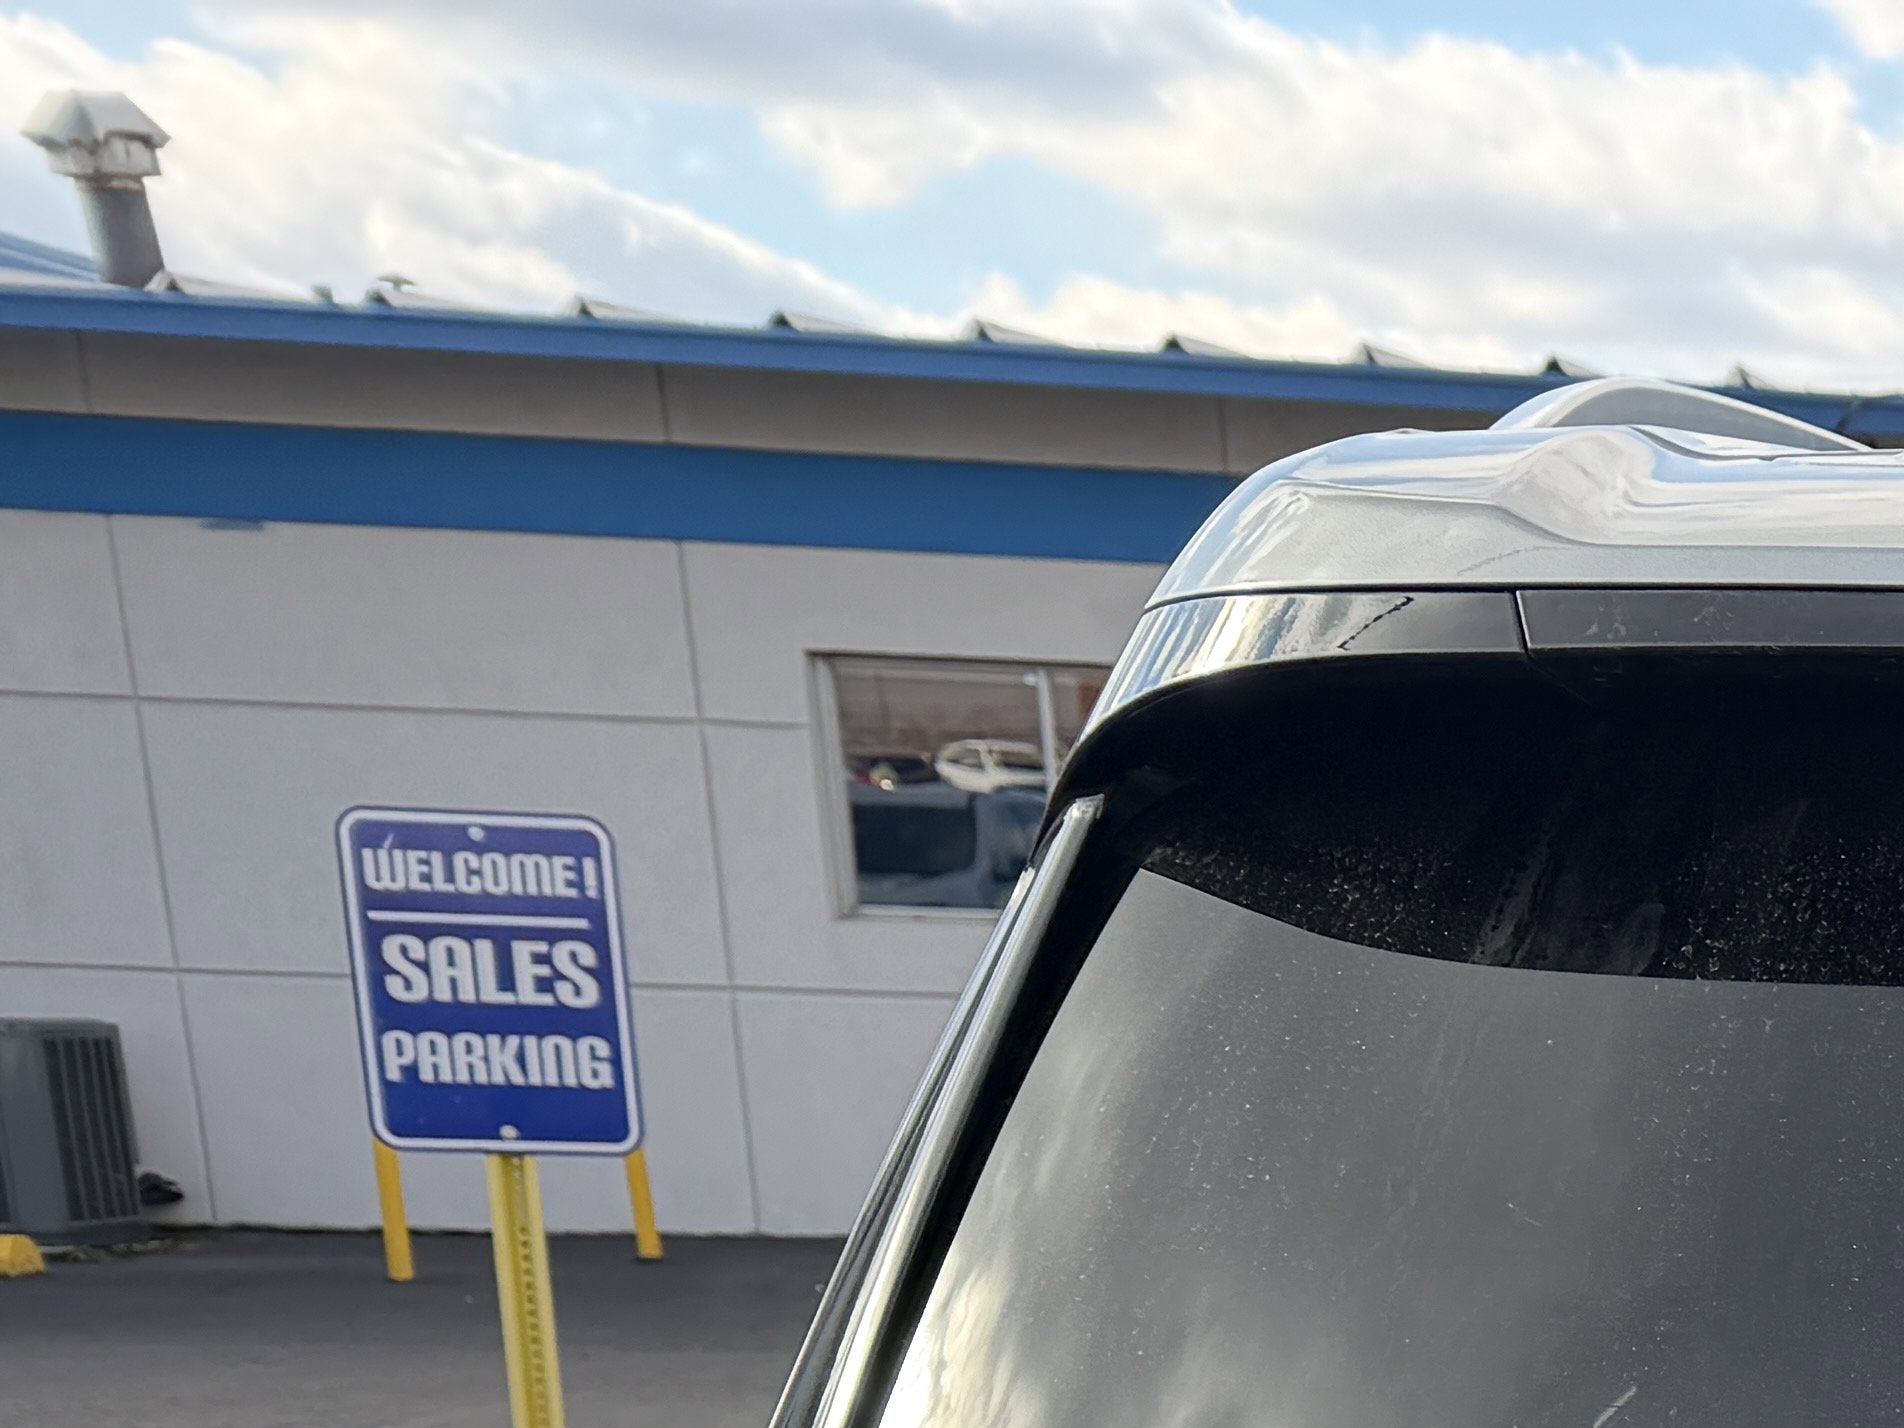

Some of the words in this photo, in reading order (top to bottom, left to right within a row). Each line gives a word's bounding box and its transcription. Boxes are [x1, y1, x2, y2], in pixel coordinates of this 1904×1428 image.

[361, 847, 599, 898] WELCOME!
[380, 933, 601, 1009] SALES
[381, 1029, 615, 1089] PARKING
